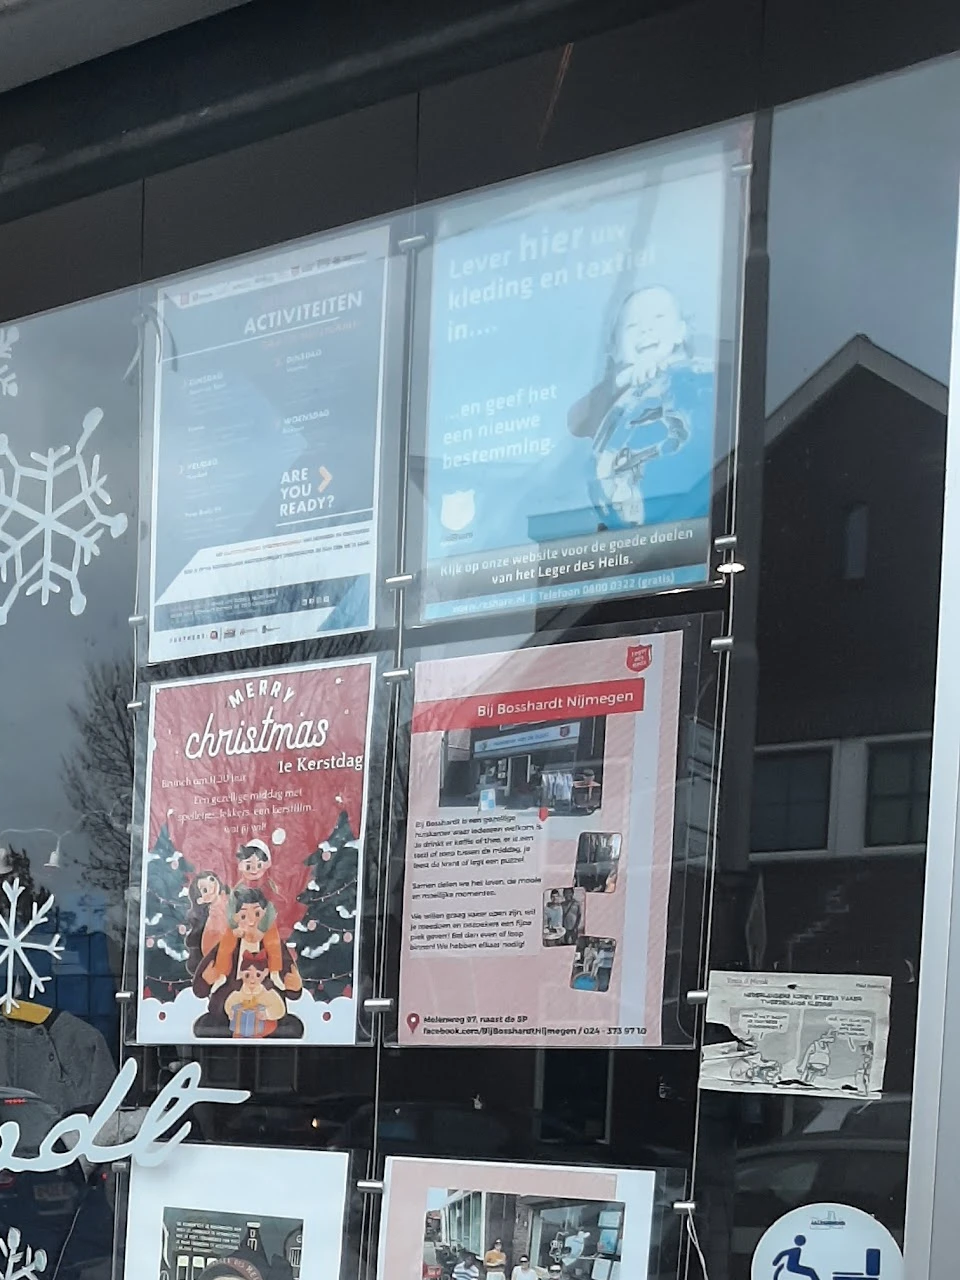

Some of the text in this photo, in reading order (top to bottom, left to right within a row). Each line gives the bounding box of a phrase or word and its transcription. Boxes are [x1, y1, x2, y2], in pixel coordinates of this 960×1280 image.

[449, 250, 512, 279] Lever
[519, 226, 584, 262] hier
[448, 276, 533, 311] kleding
[540, 267, 568, 289] en
[243, 290, 363, 334] ACTIVITEITEN
[486, 388, 524, 416] geef
[529, 384, 558, 401] het
[443, 415, 540, 446] een nieuwe
[442, 436, 556, 470] bestemming.
[280, 467, 309, 485] ARE
[279, 495, 335, 517] READY?
[280, 484, 312, 501] YOU
[440, 528, 694, 578] Kijk op onze website voor de goede doelen
[491, 553, 634, 585] van het Leger des Heils.
[227, 679, 295, 709] MERRY
[477, 690, 634, 719] Bij Bosshardt Nijmegen
[184, 706, 330, 760] christmas
[297, 752, 364, 772] Kerstdag
[161, 776, 192, 789] Brunch
[423, 1016, 465, 1024] Molenweg
[480, 1016, 503, 1024] naast
[583, 1027, 600, 1035] 024
[624, 1027, 636, 1035] 97
[637, 1027, 647, 1035] 10
